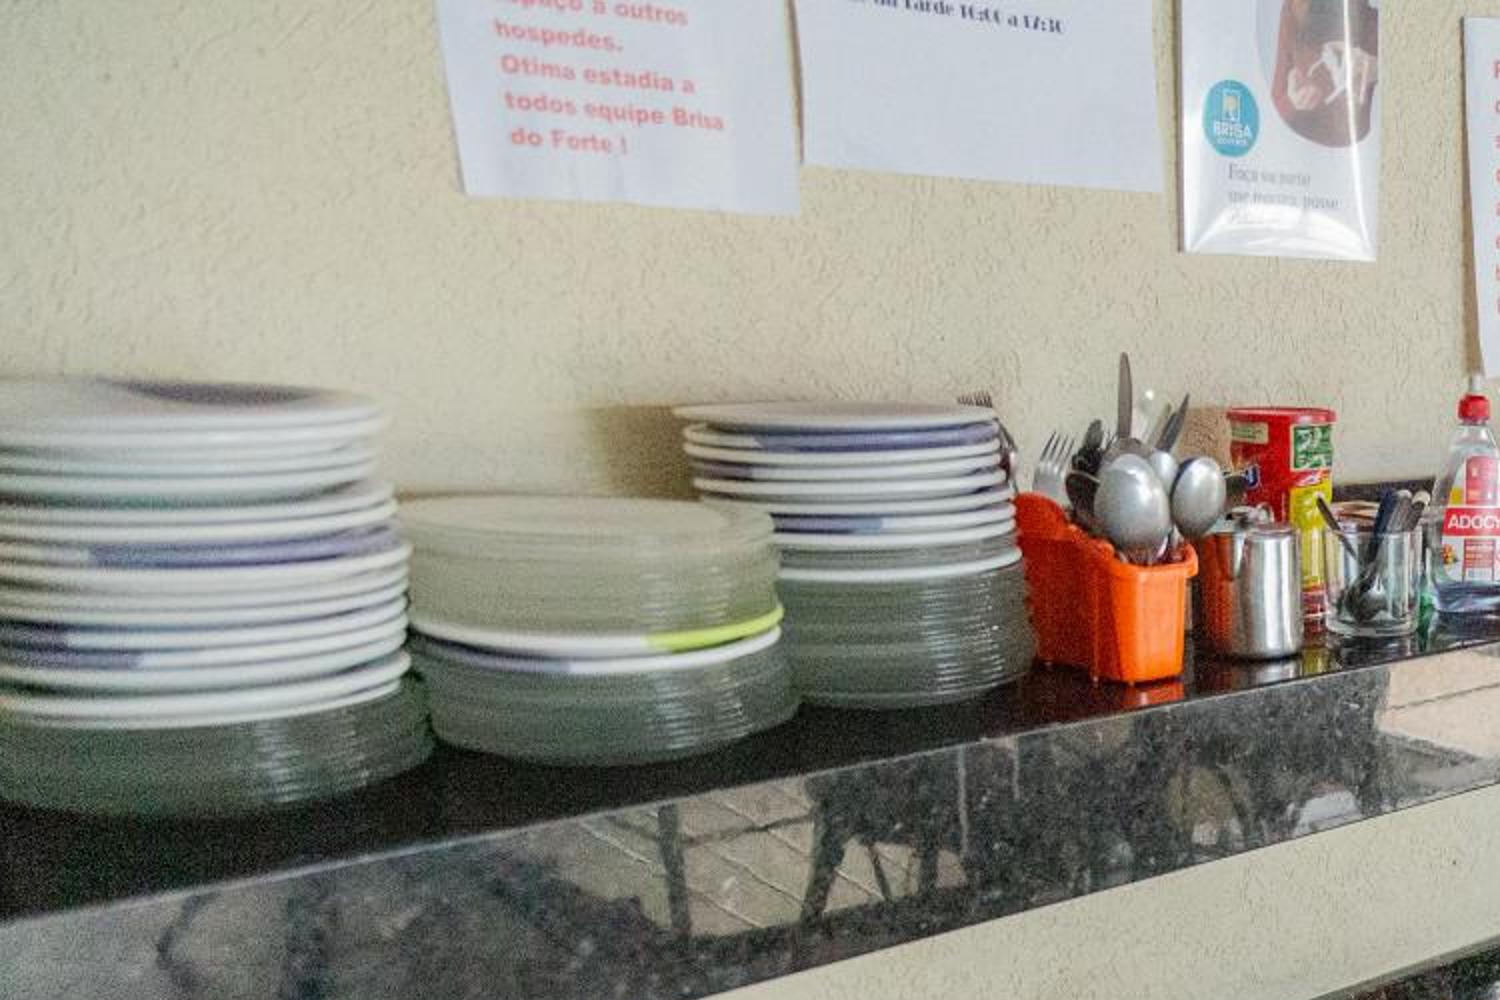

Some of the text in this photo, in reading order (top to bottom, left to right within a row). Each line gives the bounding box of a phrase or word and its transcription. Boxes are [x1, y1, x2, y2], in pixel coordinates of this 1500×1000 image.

[614, 3, 689, 26] outros
[500, 54, 696, 93] Otima estadia a
[504, 91, 725, 130] todos equipe Brisa
[510, 127, 543, 146] do
[550, 129, 611, 153] Forte
[1213, 120, 1252, 139] BRISA
